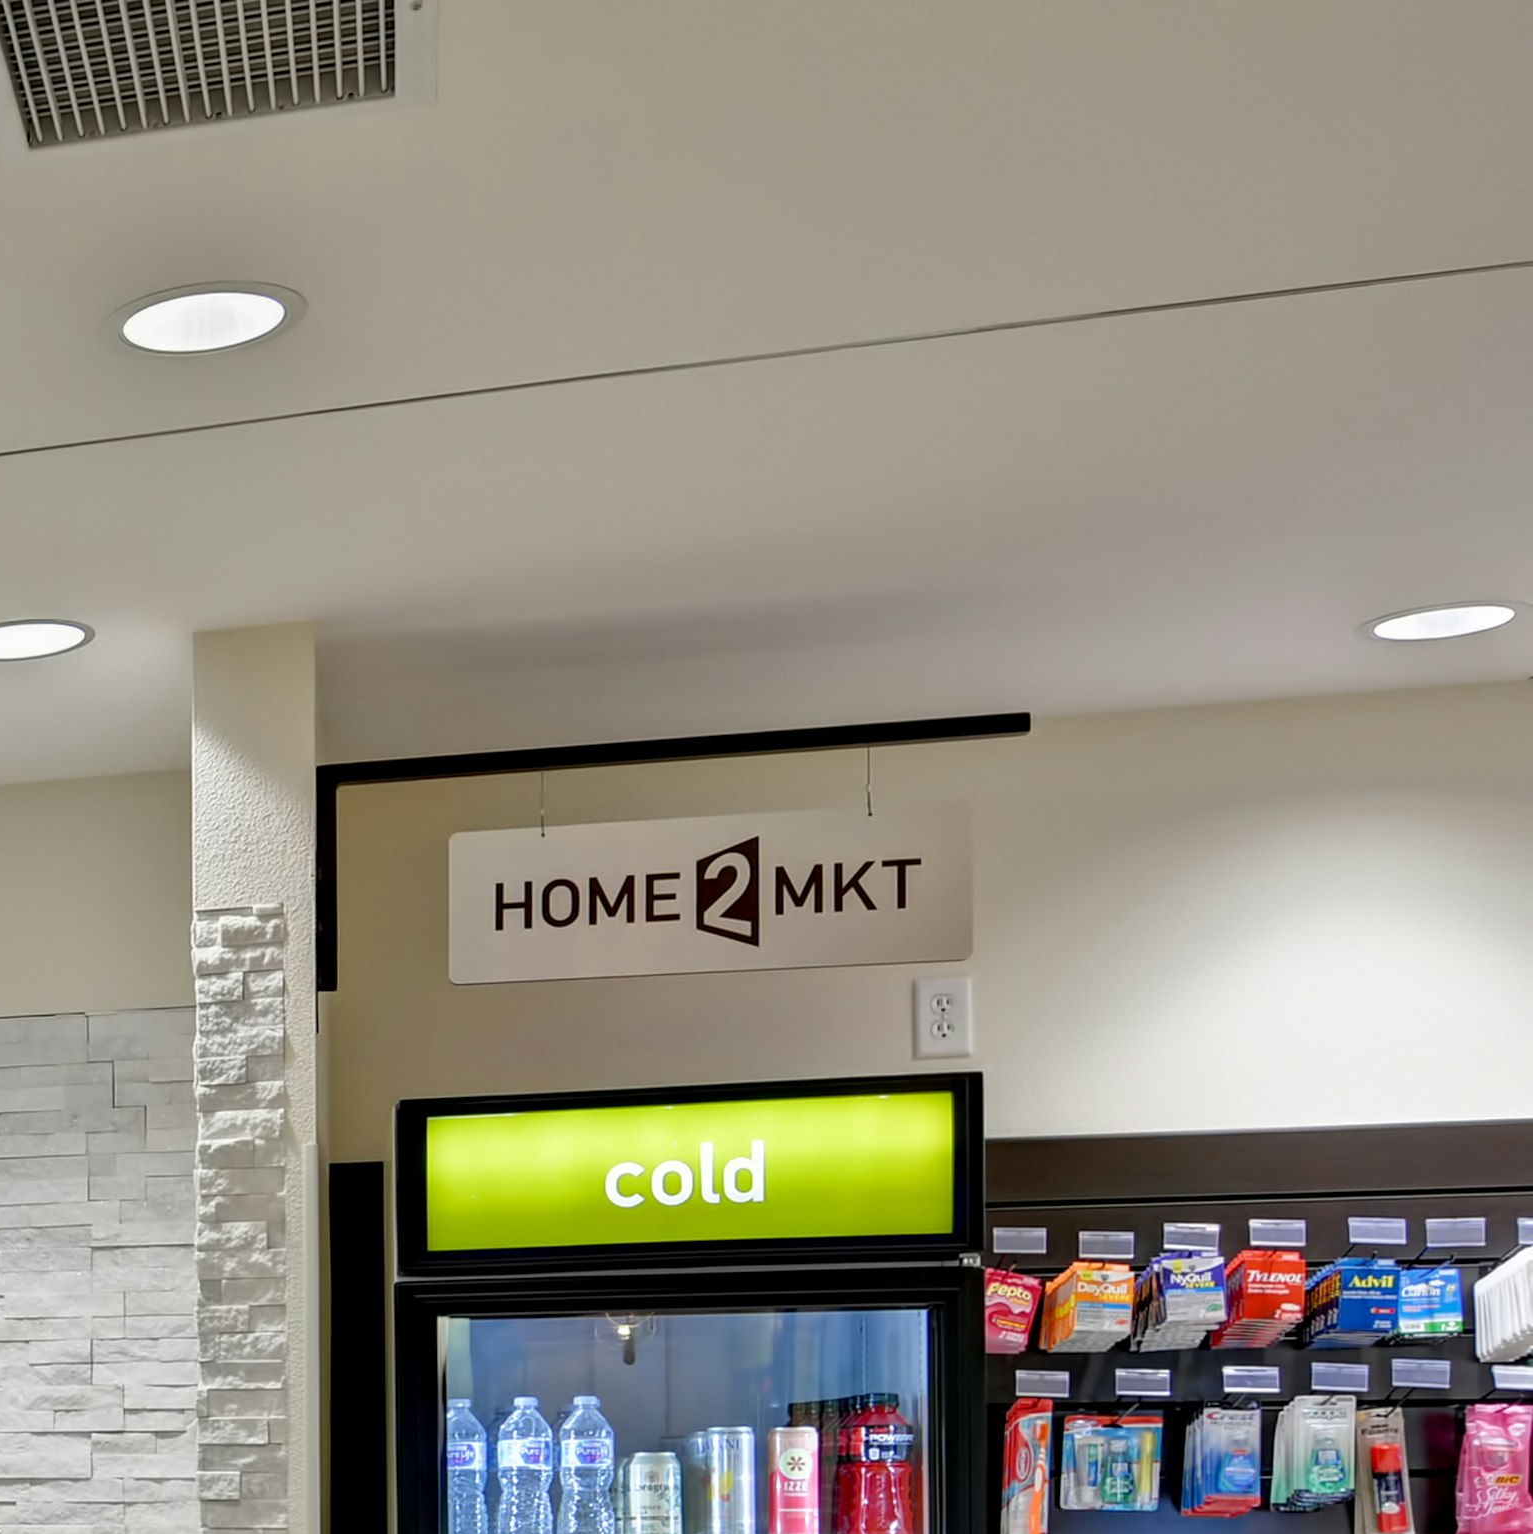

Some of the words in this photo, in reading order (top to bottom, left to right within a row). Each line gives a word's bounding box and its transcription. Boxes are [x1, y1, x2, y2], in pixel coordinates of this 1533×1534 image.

[604, 1138, 766, 1209] cold
[1169, 1271, 1213, 1287] NyQuil
[1246, 1269, 1304, 1283] TYLENOL
[1348, 1274, 1396, 1288] Advil
[986, 1281, 1032, 1301] Pepto
[1076, 1281, 1129, 1297] DayQuil
